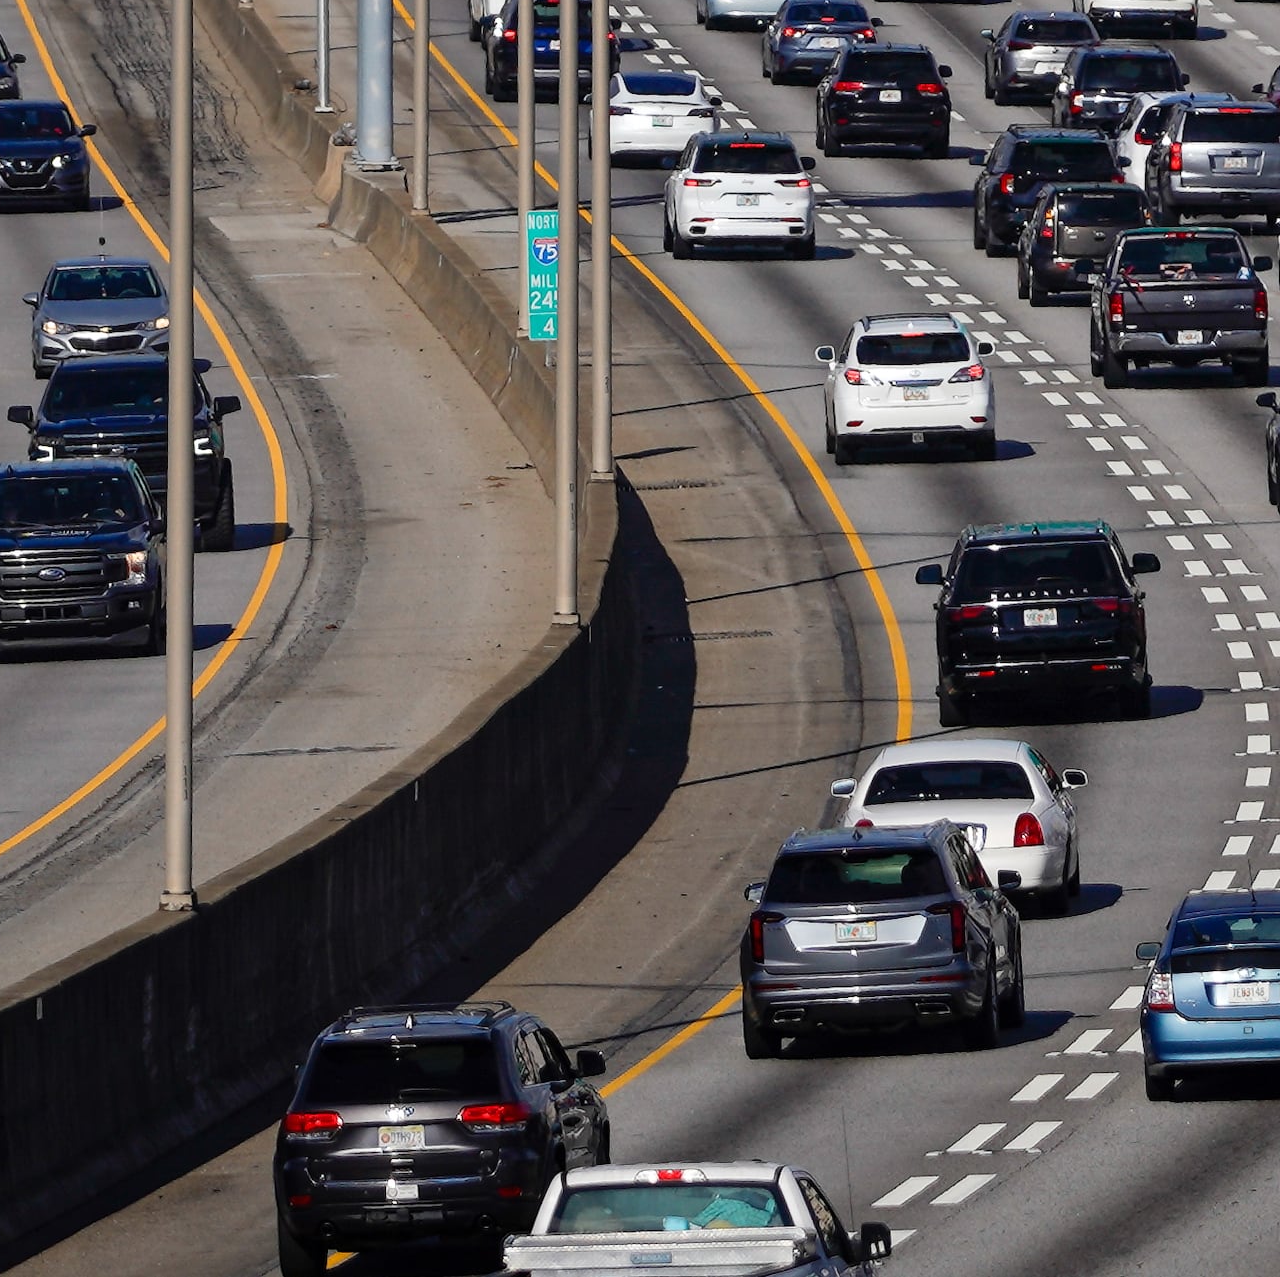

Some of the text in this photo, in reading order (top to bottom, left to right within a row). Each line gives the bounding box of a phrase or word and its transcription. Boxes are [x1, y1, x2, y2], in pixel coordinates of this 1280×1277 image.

[528, 214, 559, 230] NORT
[535, 243, 558, 260] 75
[531, 274, 559, 288] MIL
